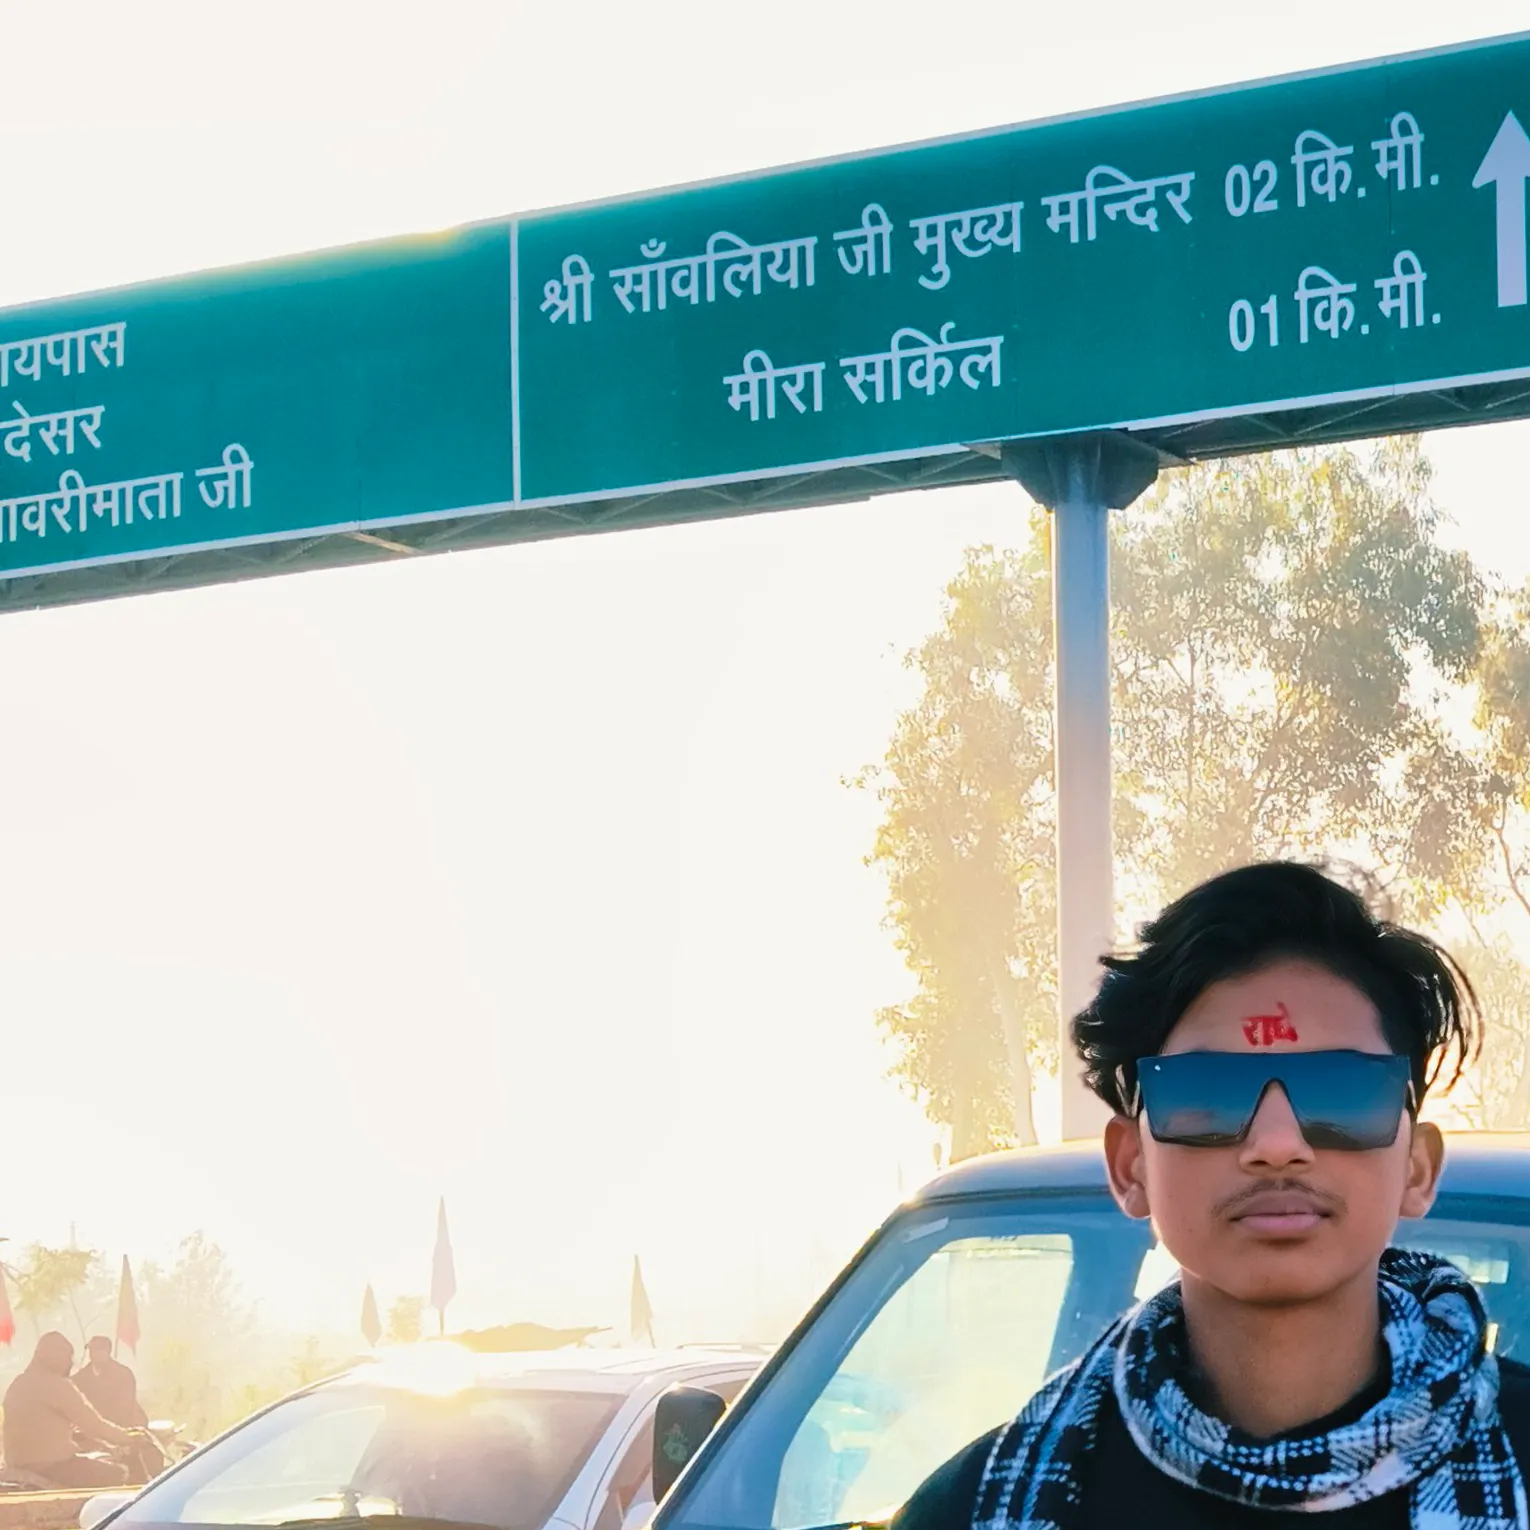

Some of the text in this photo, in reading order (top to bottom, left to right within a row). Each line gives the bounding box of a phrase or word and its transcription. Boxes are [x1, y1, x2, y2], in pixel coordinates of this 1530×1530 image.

[538, 254, 595, 325] श्री
[608, 229, 818, 314] साँवलिया
[831, 202, 893, 277] जी
[909, 201, 1024, 290] मुख्य
[1040, 165, 1196, 244] मन्दिर
[1224, 160, 1279, 217] 02
[0, 320, 128, 388] ायपास
[722, 348, 826, 422] मीरा
[839, 321, 1005, 405] सर्किल
[1228, 294, 1279, 353] 01
[0, 399, 106, 463] देसर
[0, 442, 255, 543] ावरीमाता जी
